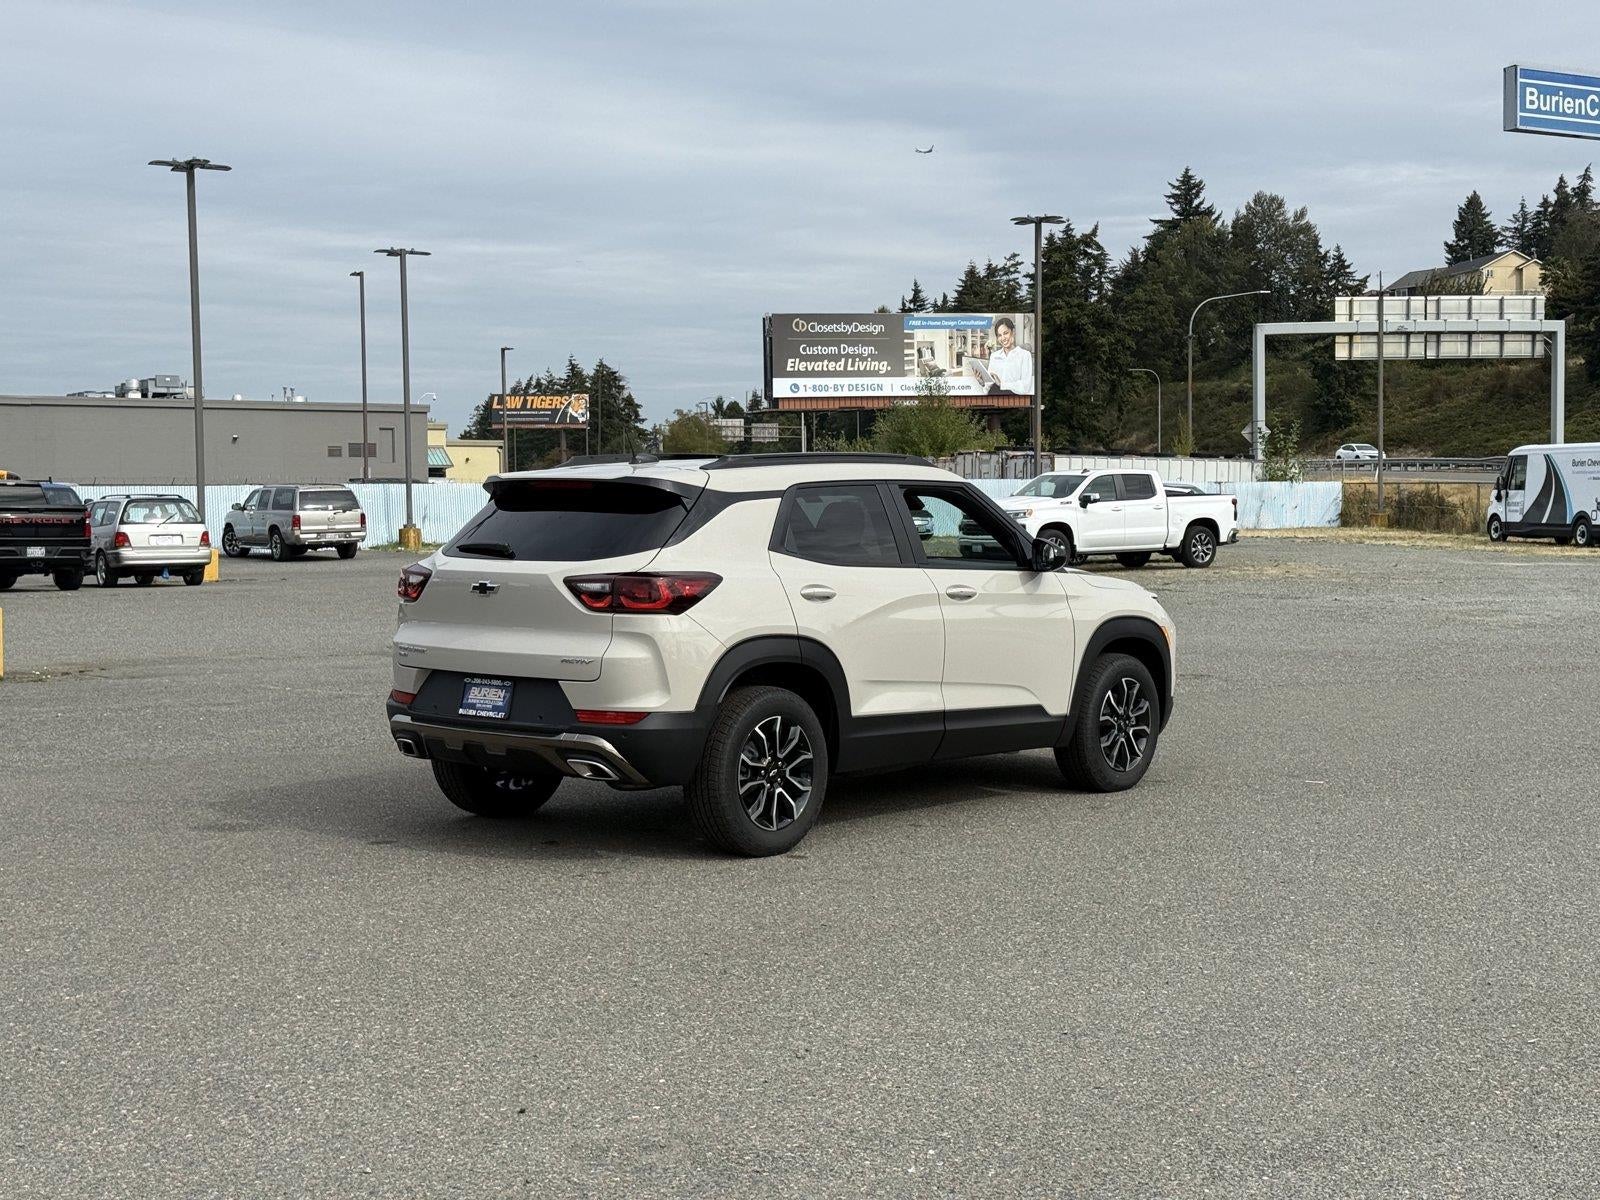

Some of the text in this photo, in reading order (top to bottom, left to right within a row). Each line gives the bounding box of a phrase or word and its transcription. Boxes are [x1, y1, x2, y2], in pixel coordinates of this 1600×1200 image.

[808, 322, 885, 335] ClosetsbyDesign
[942, 319, 957, 327] Design
[799, 343, 878, 357] Custom Design.
[786, 357, 892, 374] Elevated Living.
[803, 383, 884, 393] 1-800-BY DESIGN
[492, 395, 571, 409] LAW TIGERS
[1571, 458, 1586, 467] Burien
[0, 516, 77, 524] HEVROLET
[469, 686, 506, 699] BURIEN
[476, 709, 506, 719] CHEVROLET
